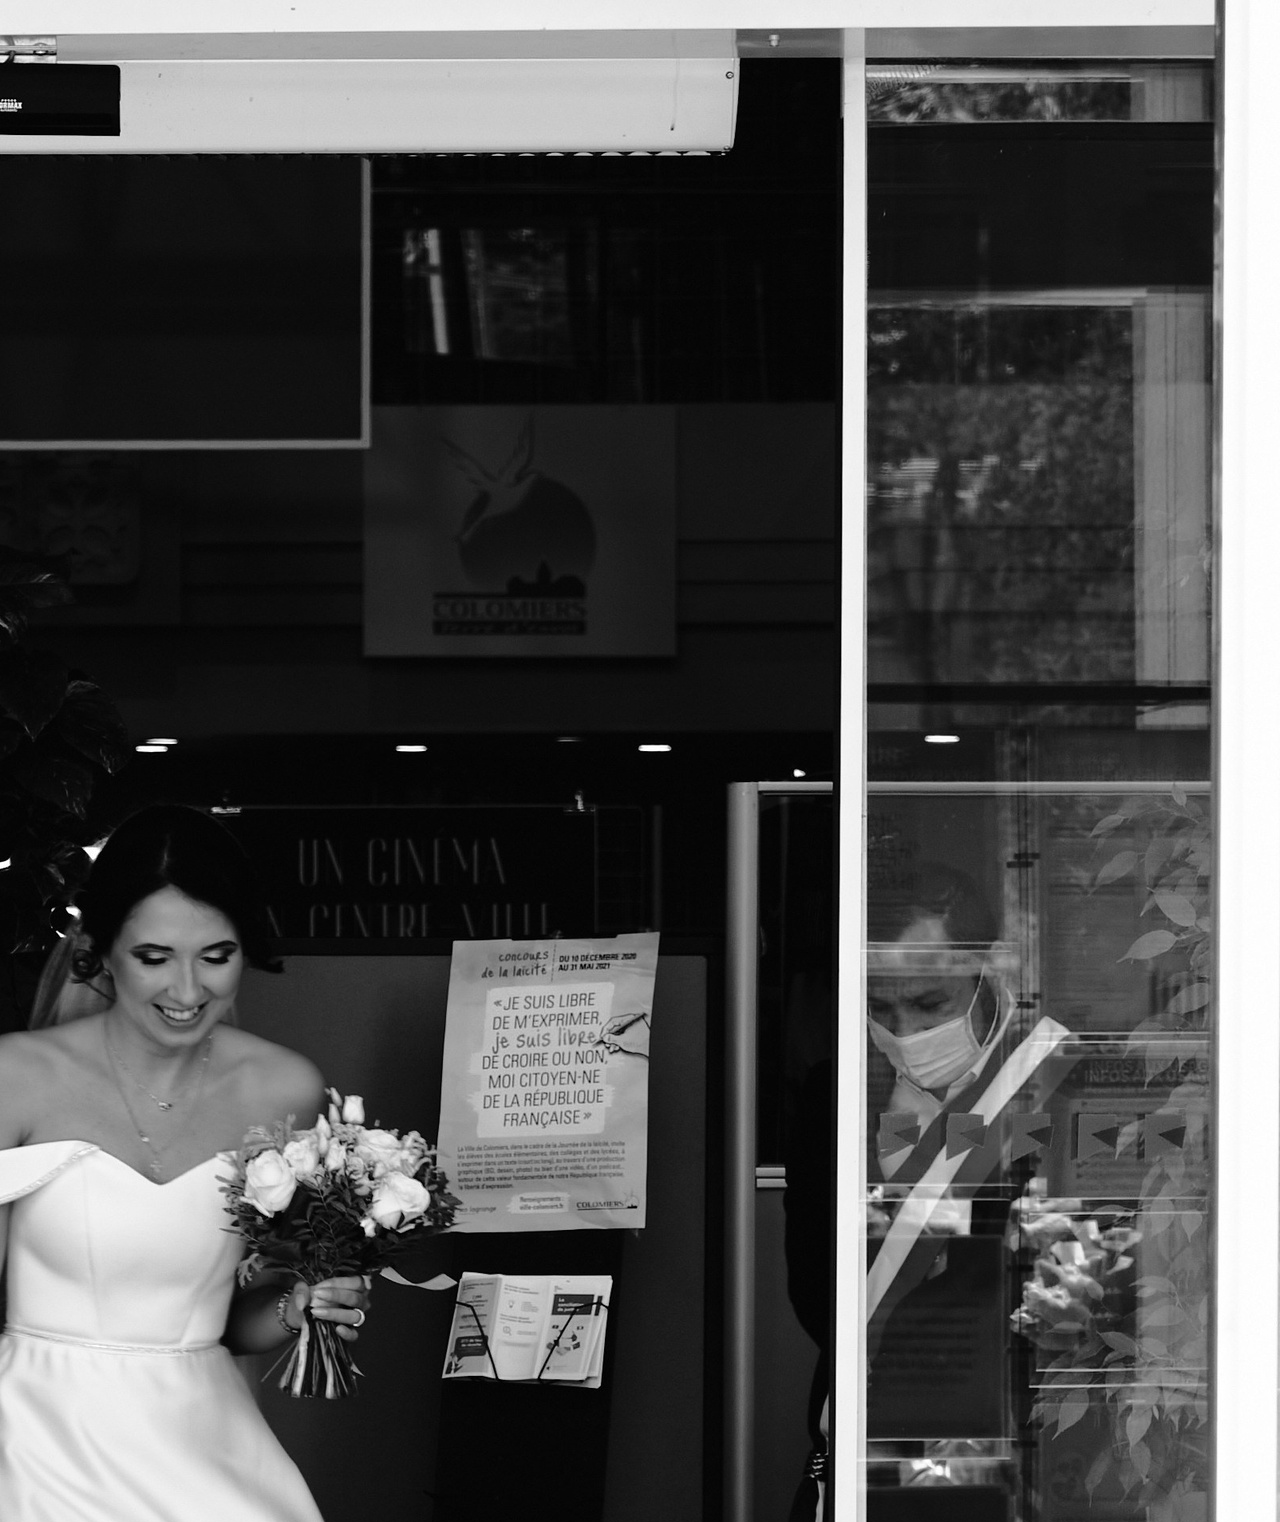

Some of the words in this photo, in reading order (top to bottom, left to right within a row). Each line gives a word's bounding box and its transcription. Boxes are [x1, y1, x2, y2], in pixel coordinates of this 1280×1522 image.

[433, 600, 588, 619] COLOMIERS
[298, 837, 344, 887] UN
[368, 828, 507, 887] CINÉMA
[499, 950, 549, 962] concours
[559, 955, 570, 963] DU
[571, 954, 579, 962] 10
[580, 953, 619, 962] DÉCEMBRE
[621, 952, 637, 960] 2020
[481, 966, 493, 978] de
[499, 967, 508, 977] la
[512, 963, 547, 976] laïcité
[558, 963, 569, 971] AU
[570, 963, 579, 971] 31
[596, 962, 610, 970] 2021
[523, 994, 555, 1009] SUIS
[559, 992, 595, 1008] LIBRE
[492, 1016, 510, 1031] DE
[514, 1011, 602, 1029] M'EXPRIMER,
[492, 1032, 510, 1054] je
[516, 1030, 551, 1048] suis
[558, 1027, 596, 1047] libre
[482, 1055, 499, 1070] DE
[502, 1052, 548, 1069] CROIRE
[552, 1051, 571, 1067] OU
[575, 1049, 608, 1065] NON,
[488, 1074, 515, 1089] MOI
[519, 1069, 601, 1088] CITOYEN-NE
[483, 1094, 500, 1109] DE
[504, 1093, 520, 1108] LA
[524, 1088, 604, 1107] RÉPUBLIQUE
[503, 1109, 580, 1129] FRANÇAISE
[576, 1200, 624, 1208] COLOMIERS
